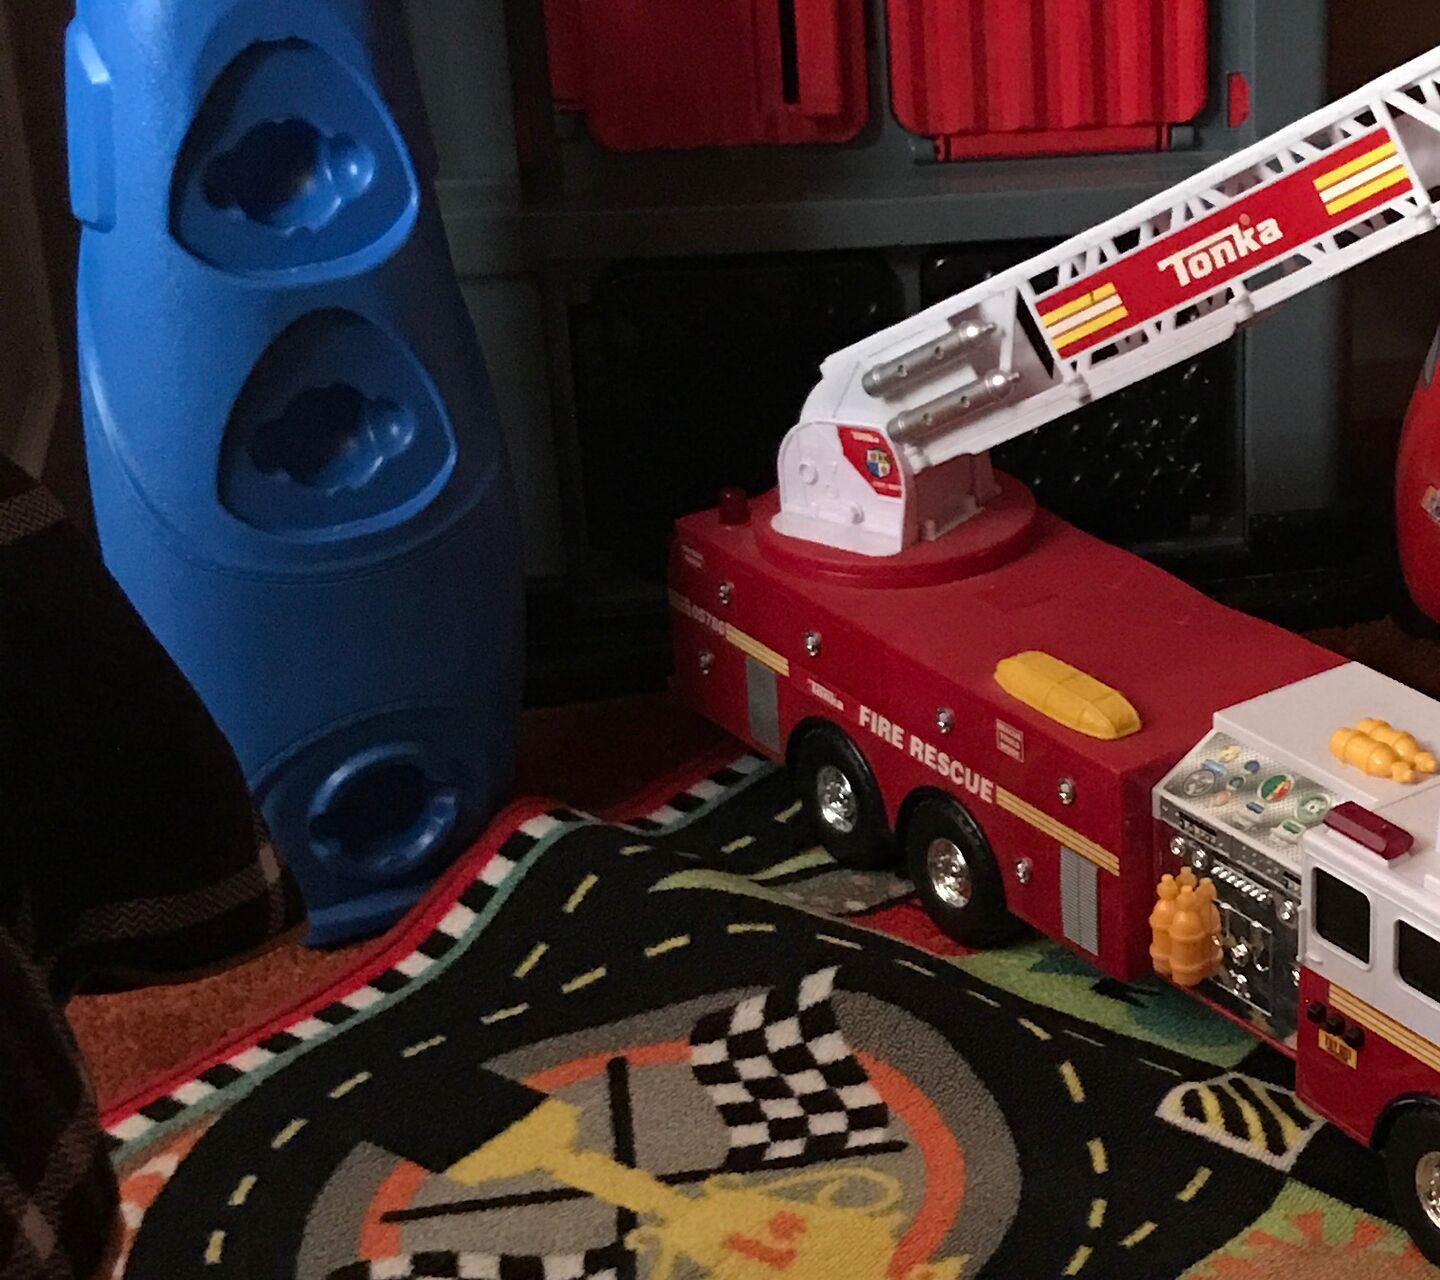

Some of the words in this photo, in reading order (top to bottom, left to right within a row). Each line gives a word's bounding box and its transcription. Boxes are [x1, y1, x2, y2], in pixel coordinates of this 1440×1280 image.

[1156, 217, 1284, 288] Tonka
[858, 704, 904, 750] FIRE
[909, 734, 995, 804] RESCUE
